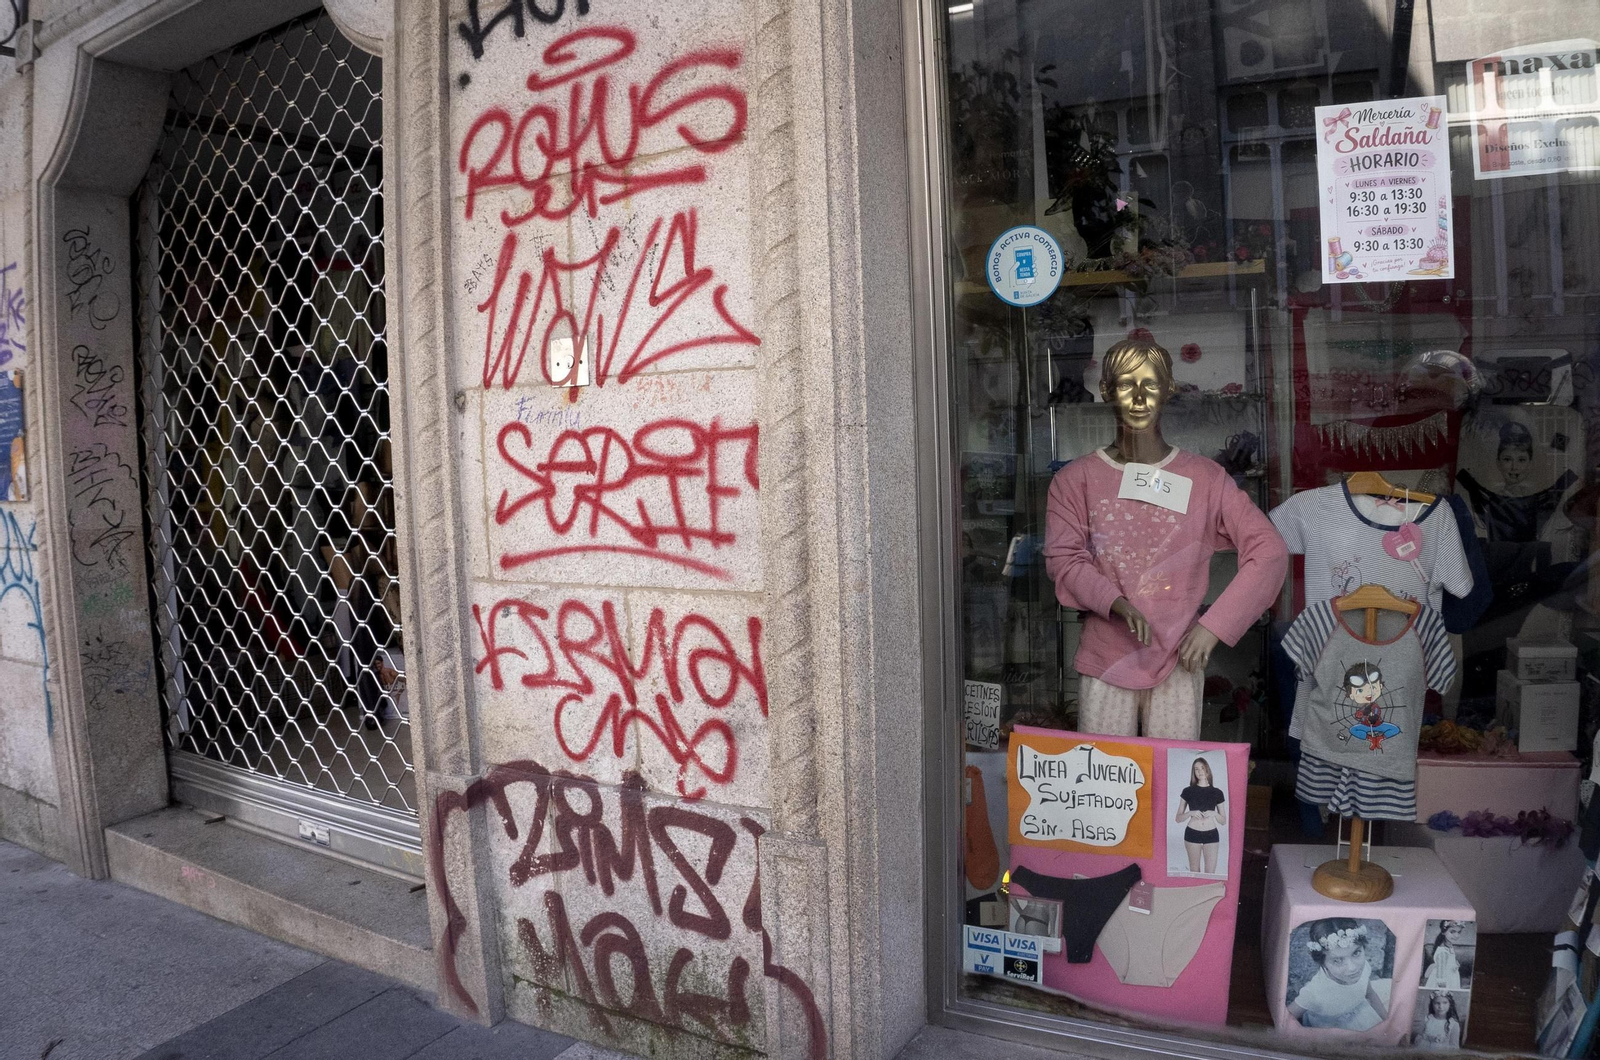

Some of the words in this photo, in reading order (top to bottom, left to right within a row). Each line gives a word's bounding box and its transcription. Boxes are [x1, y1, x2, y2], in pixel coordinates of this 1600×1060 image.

[1352, 106, 1415, 124] Mercería
[1335, 126, 1433, 153] Saldaña
[1485, 142, 1530, 154] Diseños
[1349, 152, 1419, 172] HORARIO
[1355, 179, 1377, 188] LUNES
[1380, 178, 1386, 186] A
[1388, 176, 1416, 186] VIERNES
[1349, 190, 1375, 203] 9:30
[1380, 193, 1388, 201] a
[1391, 188, 1423, 201] 13:30
[1346, 204, 1379, 218] 16:30
[1383, 206, 1391, 215] a
[1394, 202, 1427, 215] 19:30
[1371, 224, 1404, 236] SÁBADO
[1353, 240, 1379, 252] 9:30
[1382, 242, 1390, 251] a
[1393, 238, 1424, 250] 13:30
[993, 252, 1002, 283] BONOS
[1000, 232, 1030, 250] ACTIVA
[1033, 234, 1058, 277] COMERCIO
[1134, 471, 1172, 494] 5.95
[972, 930, 1000, 946] VISA
[1008, 937, 1037, 952] VISA
[980, 953, 990, 965] V
[1006, 970, 1035, 981] ServiRed
